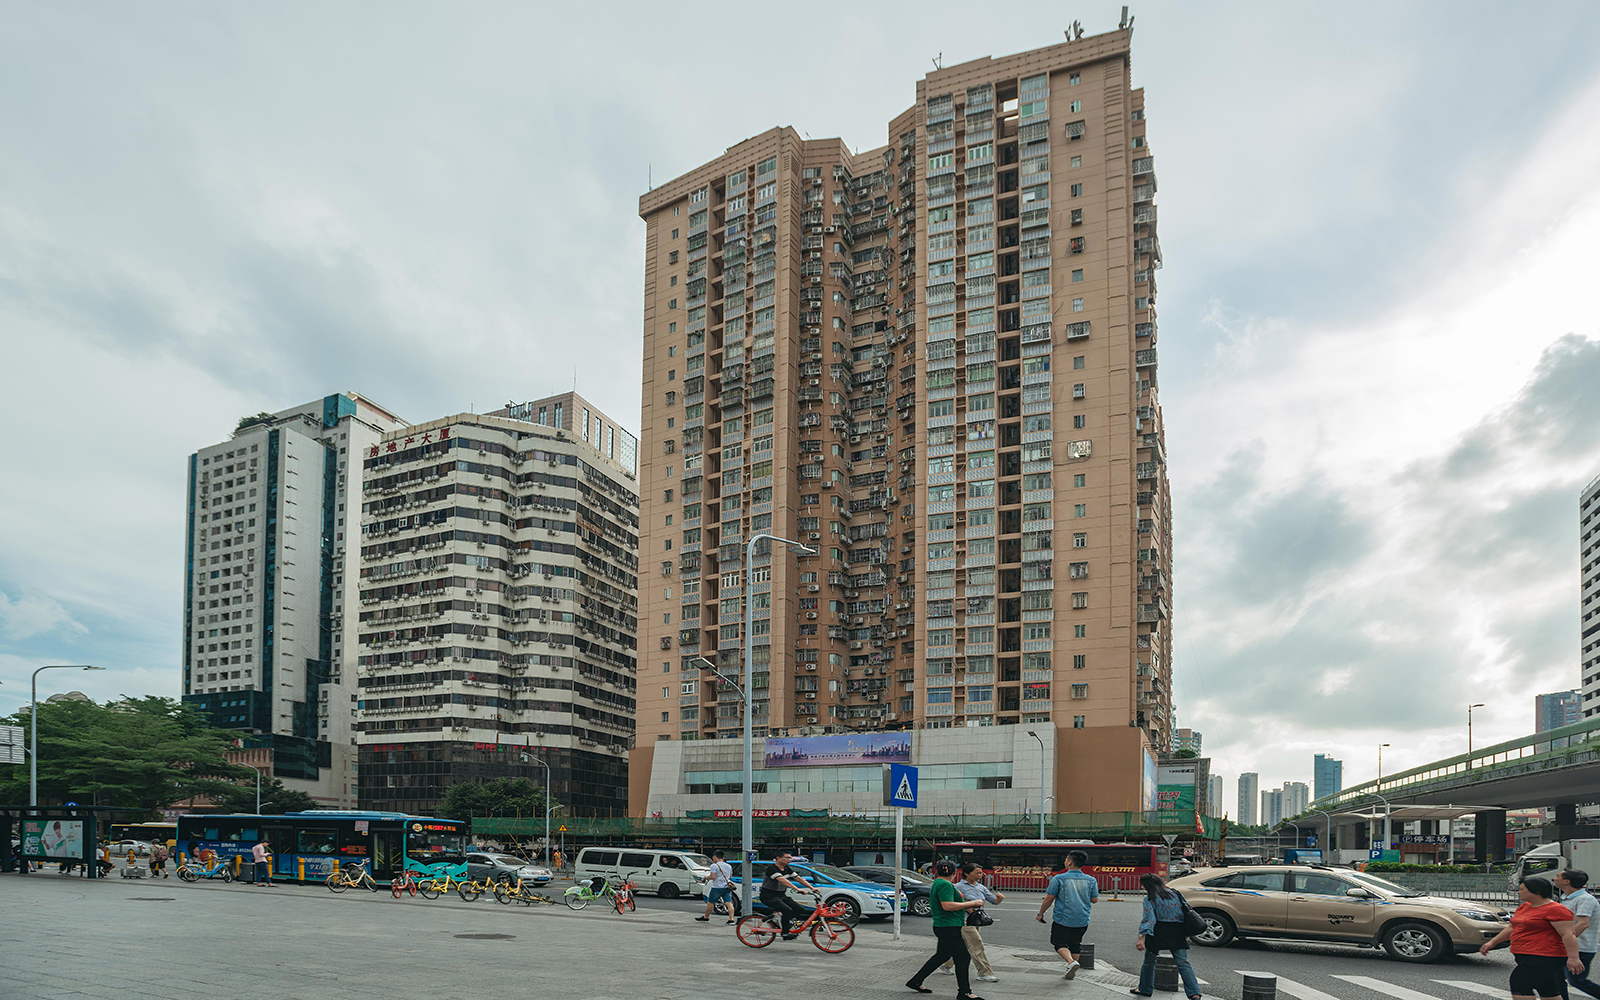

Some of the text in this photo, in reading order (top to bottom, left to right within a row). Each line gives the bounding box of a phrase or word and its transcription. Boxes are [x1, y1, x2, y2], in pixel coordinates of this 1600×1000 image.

[369, 427, 451, 458] 房地产大厦
[1413, 835, 1447, 843] 停车场
[1371, 850, 1380, 858] P
